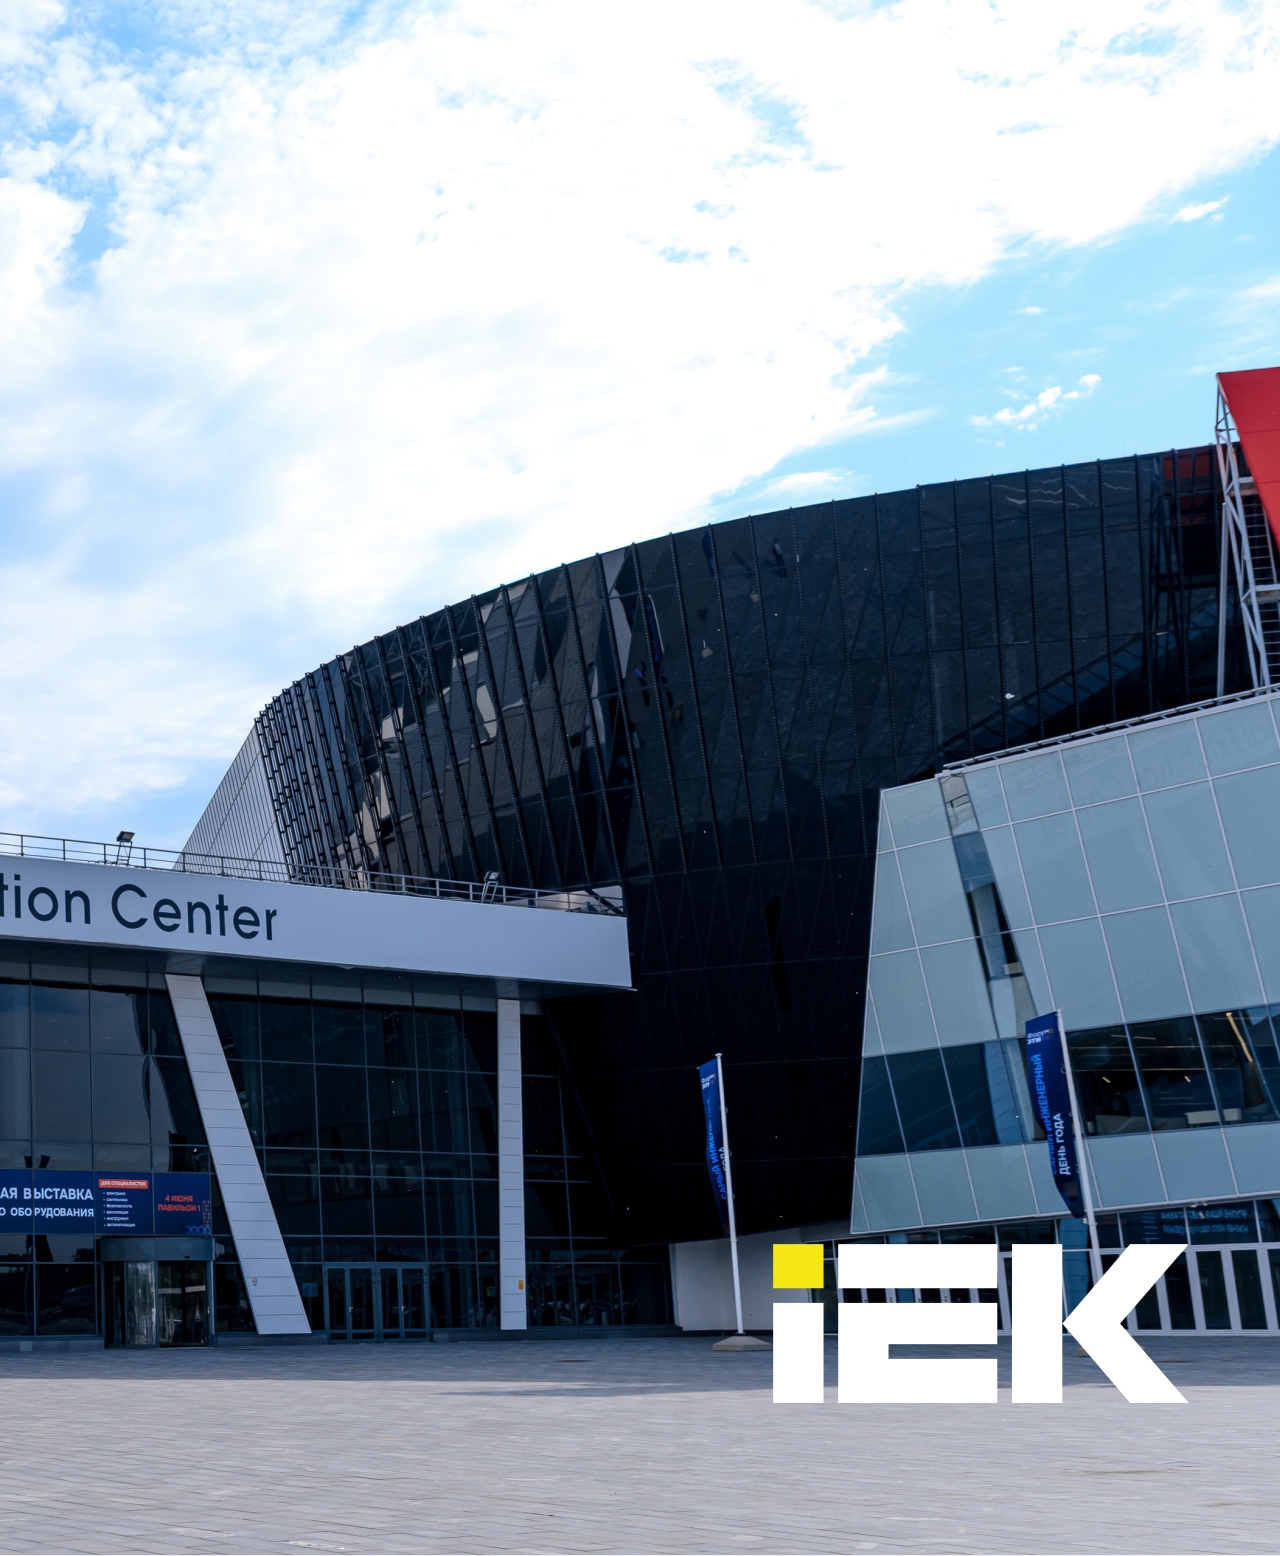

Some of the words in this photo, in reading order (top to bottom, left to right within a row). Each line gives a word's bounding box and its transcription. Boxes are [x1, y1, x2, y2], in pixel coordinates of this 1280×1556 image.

[111, 883, 277, 941] Center
[1031, 1053, 1052, 1131] ИНЖЕНЕРНЫЙ
[1052, 1113, 1065, 1143] ГОДА
[1058, 1145, 1072, 1175] ДЕНЬ
[157, 1204, 196, 1212] ПАВИЛЬОН
[165, 1194, 170, 1202] 4
[171, 1195, 193, 1203] ИЮНЯ
